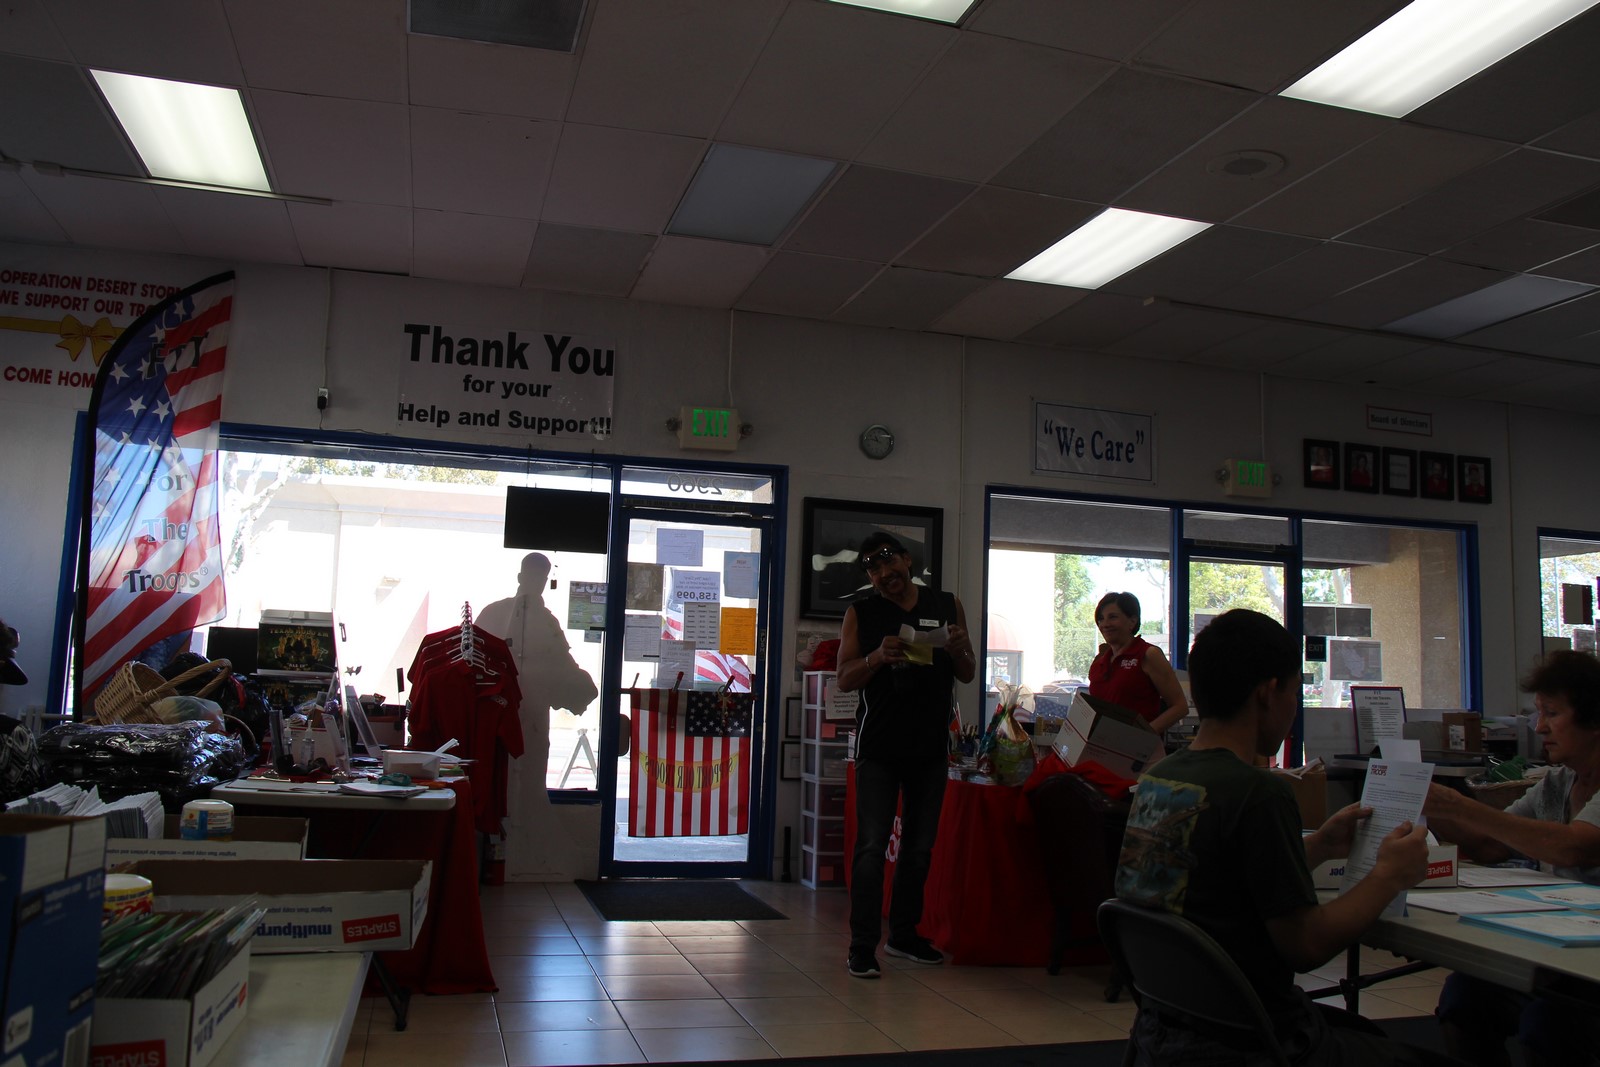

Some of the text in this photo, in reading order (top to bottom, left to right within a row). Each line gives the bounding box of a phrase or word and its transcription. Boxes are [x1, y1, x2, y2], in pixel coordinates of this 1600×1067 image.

[0, 269, 183, 300] OPERATION DESERT STOR
[25, 292, 88, 311] SUPPORT
[94, 299, 123, 315] OUR
[404, 323, 615, 377] Thank You
[4, 366, 97, 389] COME HOM
[463, 374, 552, 399] for your
[398, 402, 611, 436] Help and Support!!
[692, 408, 730, 438] EXIT
[1044, 419, 1144, 463] “We Care”
[1238, 460, 1265, 487] EXIT
[141, 518, 189, 543] The
[1329, 864, 1452, 878] STAPLE per
[253, 921, 397, 939] STAPLES multipurp
[94, 1050, 160, 1067] STAPLE
